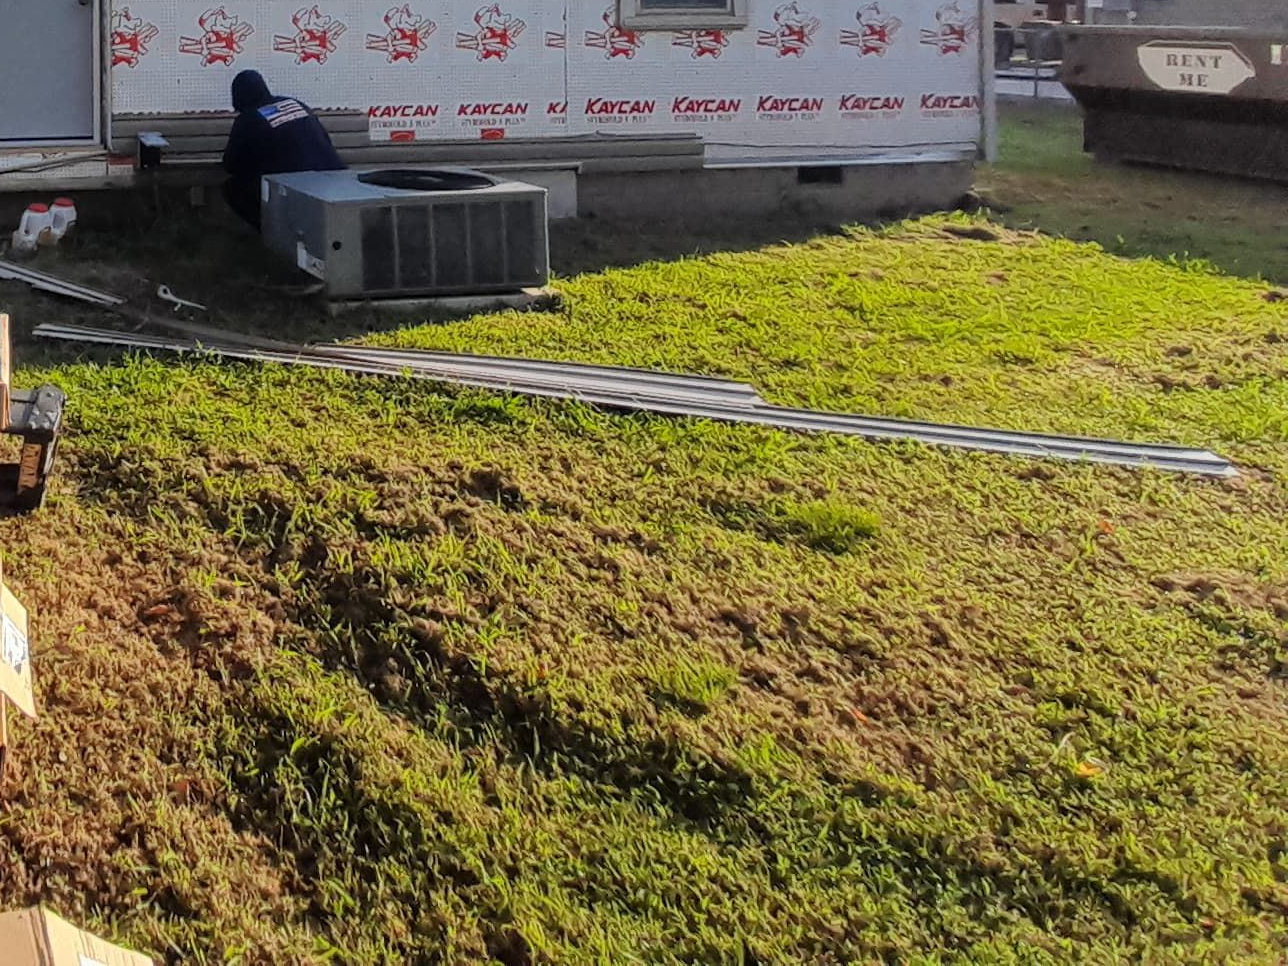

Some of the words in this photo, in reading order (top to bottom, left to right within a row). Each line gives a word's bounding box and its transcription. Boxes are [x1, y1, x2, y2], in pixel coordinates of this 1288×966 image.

[1165, 53, 1222, 70] RENT
[1178, 73, 1209, 88] ME
[457, 103, 528, 116] KAYCAN
[585, 97, 656, 114] KAYCAN
[671, 96, 741, 113] KAYCAN
[757, 95, 823, 111] KAYCAN
[839, 94, 904, 110] KAYCAN
[368, 105, 439, 118] KAYCAN
